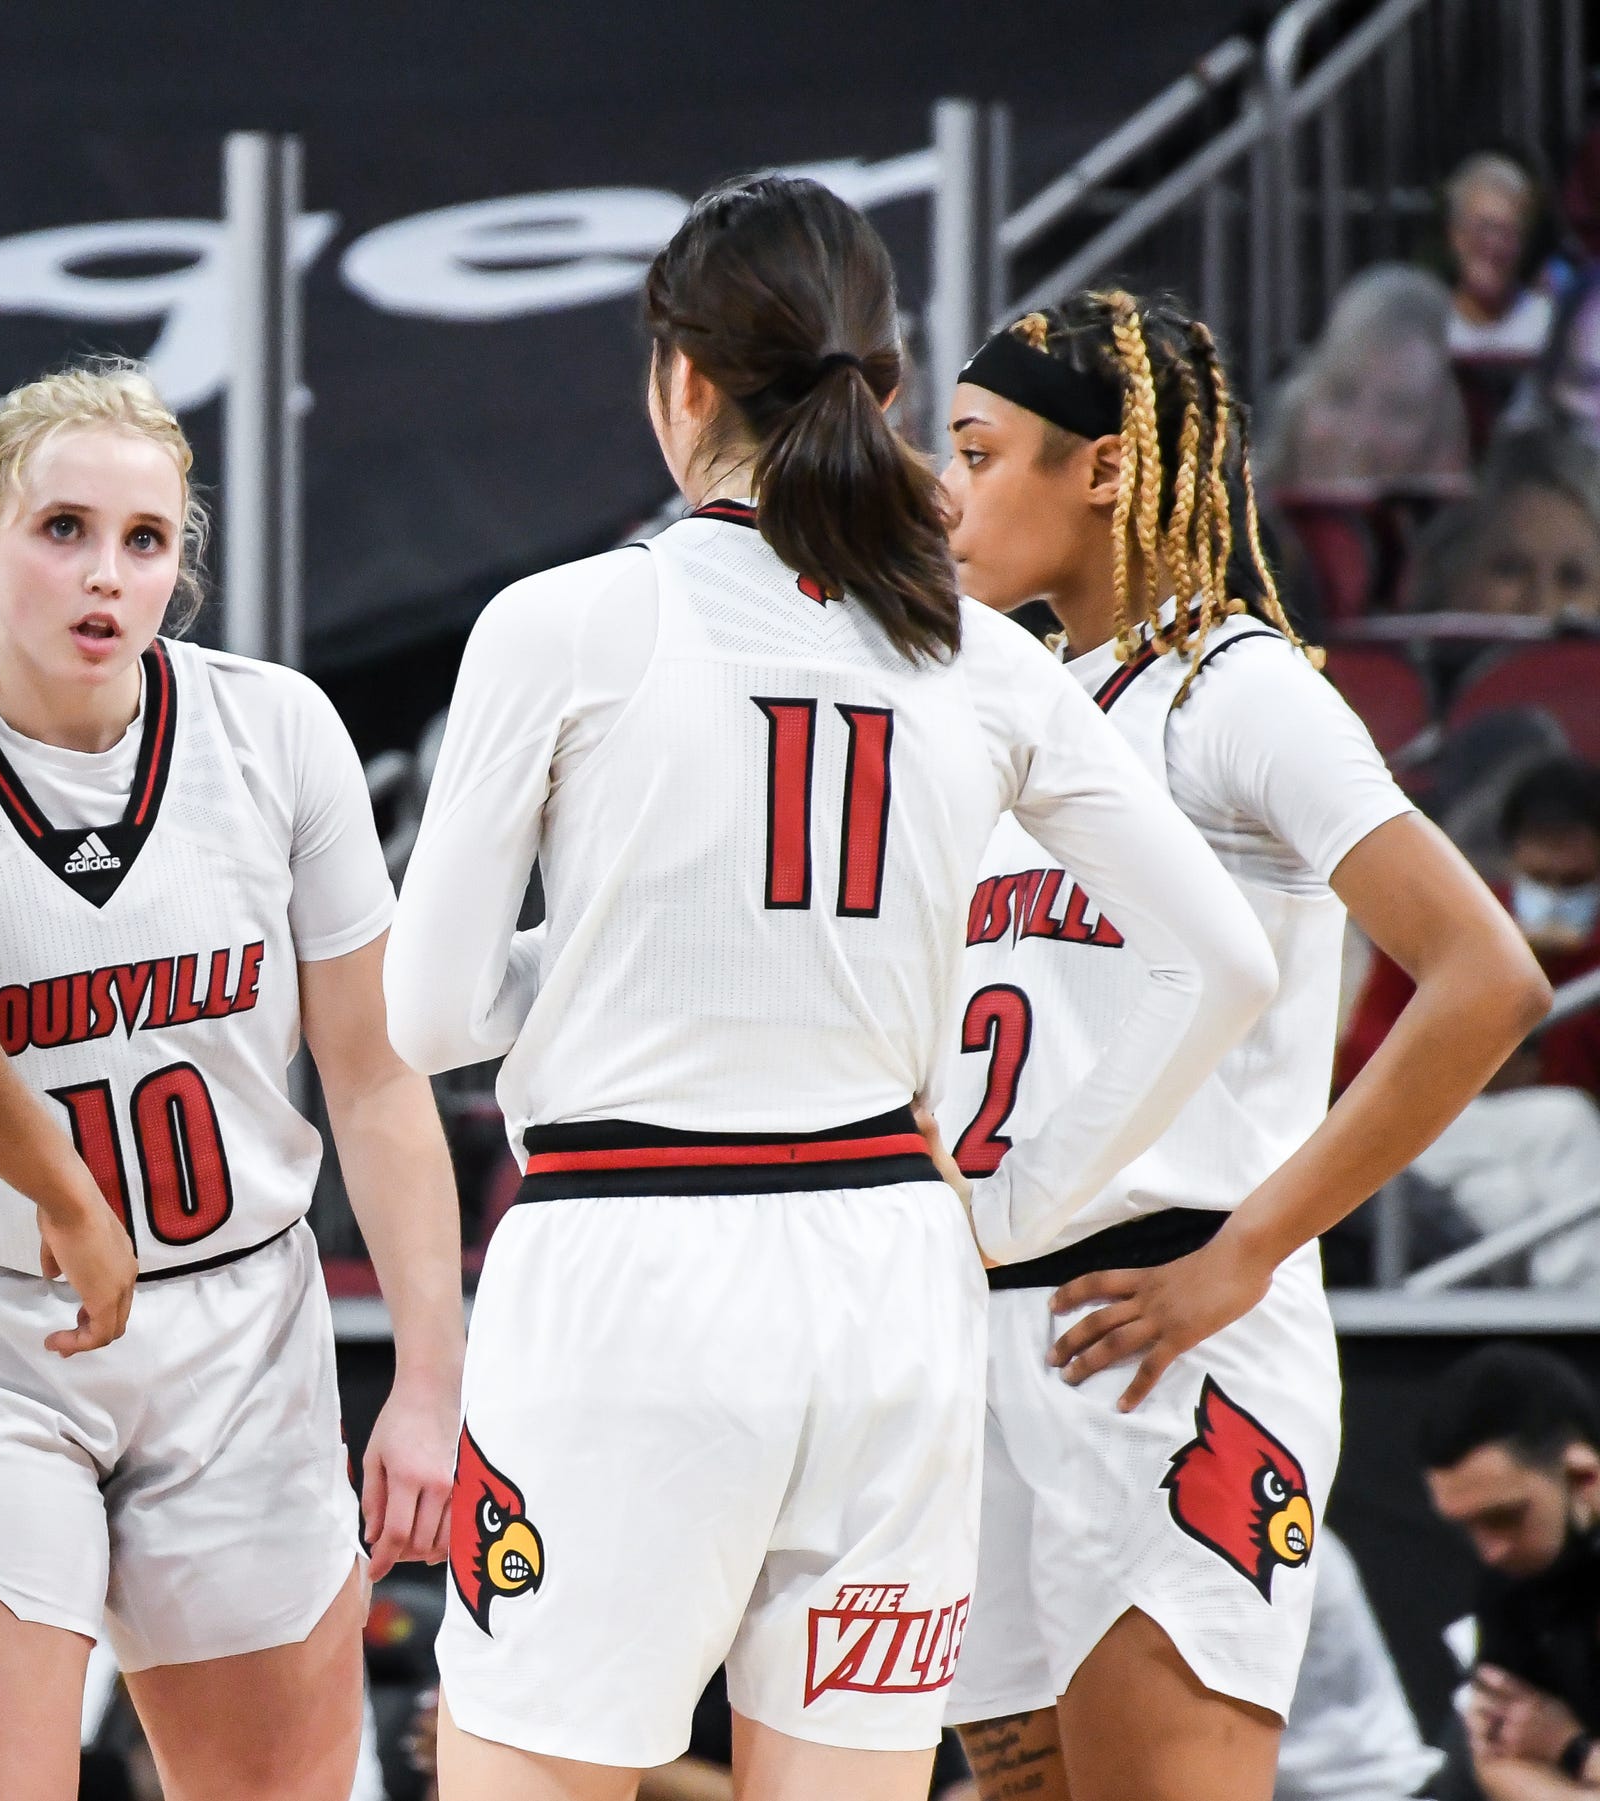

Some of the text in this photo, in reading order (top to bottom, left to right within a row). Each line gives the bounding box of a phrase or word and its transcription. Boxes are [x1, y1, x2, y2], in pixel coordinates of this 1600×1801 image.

[64, 855, 121, 874] adidas
[750, 695, 894, 919] 11
[951, 982, 1033, 1180] 2
[43, 1060, 233, 1262] 10
[803, 1592, 971, 1709] VILLE
[834, 1583, 910, 1613] THE
